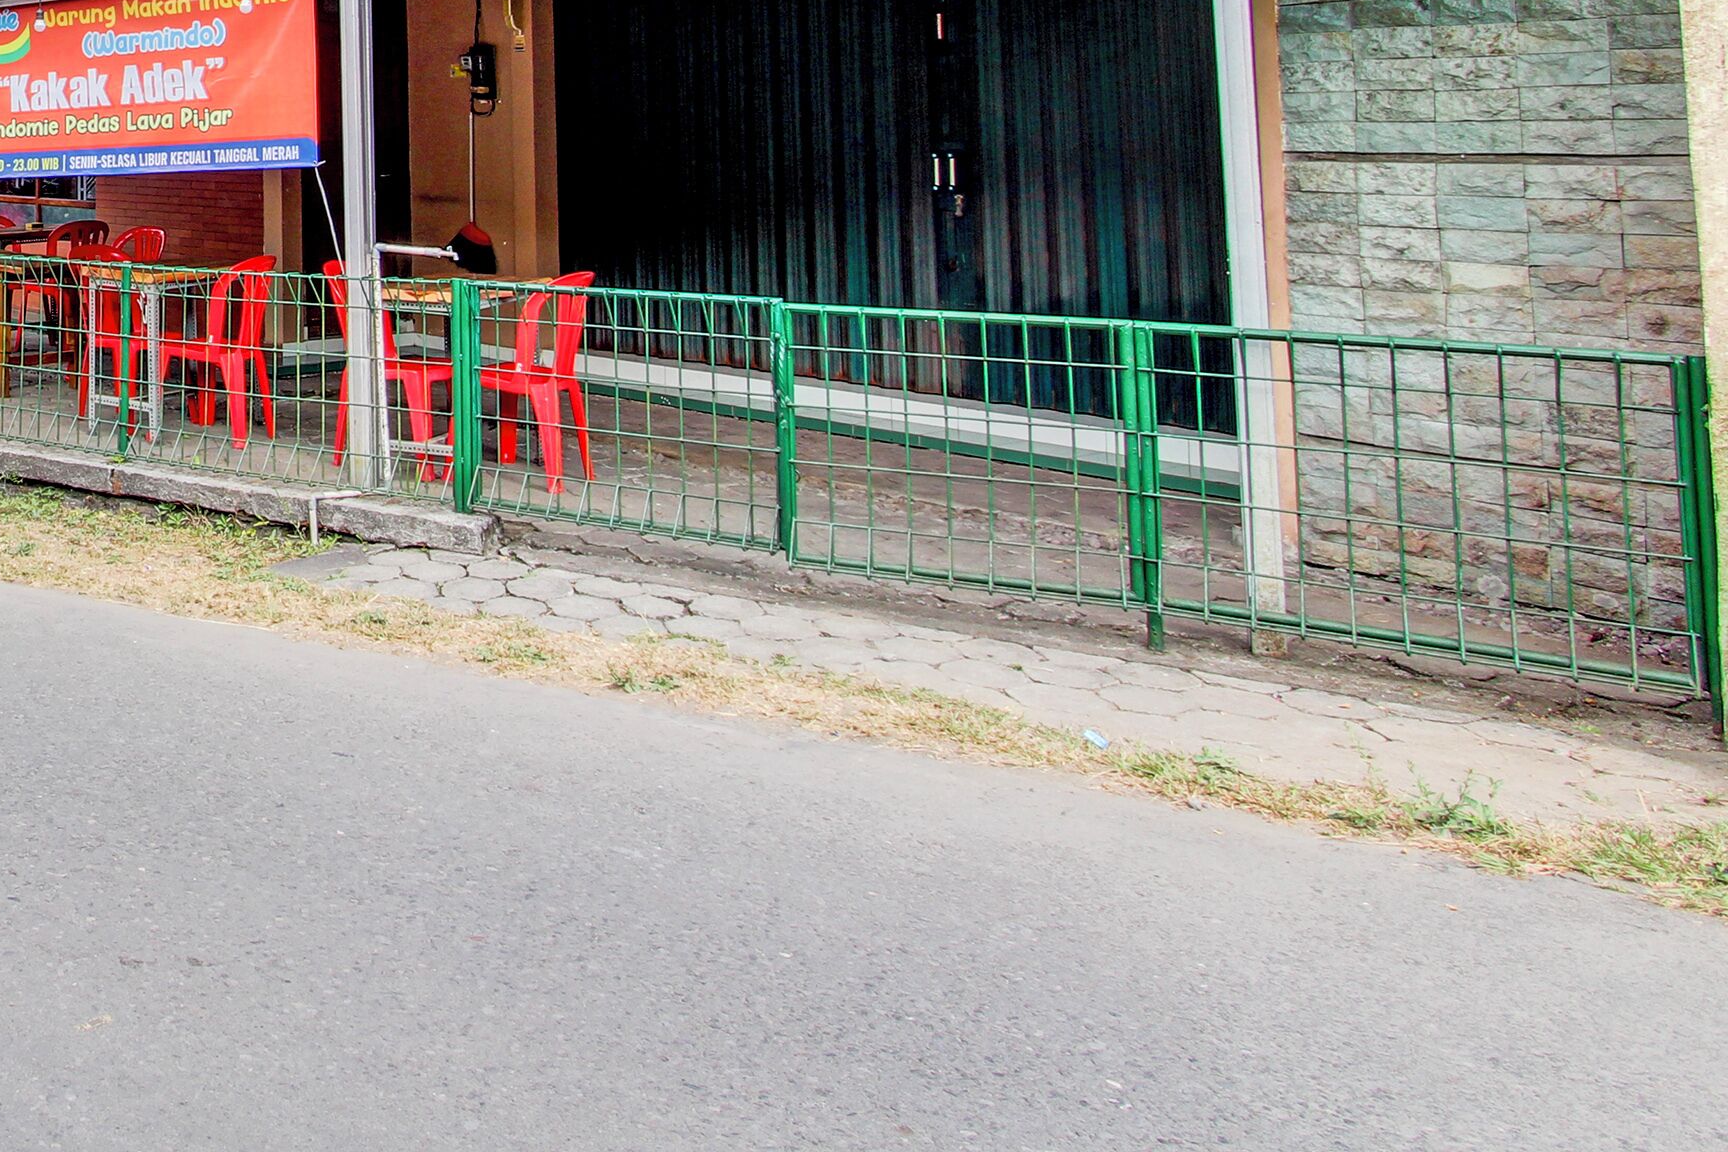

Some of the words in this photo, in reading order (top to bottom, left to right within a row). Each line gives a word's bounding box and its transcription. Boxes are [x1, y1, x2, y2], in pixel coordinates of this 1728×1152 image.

[81, 17, 227, 59] (Warmindo)
[65, 113, 121, 135] Pedas
[126, 110, 175, 132] Lava
[180, 106, 233, 133] Pijar
[13, 158, 39, 172] 23.00
[41, 156, 60, 171] WIB
[69, 152, 137, 169] SENIN-SELASA
[139, 151, 167, 167] LIBUR
[170, 149, 211, 165] KECUALI
[213, 147, 260, 164] TANGGAL
[262, 145, 300, 162] MERAH
